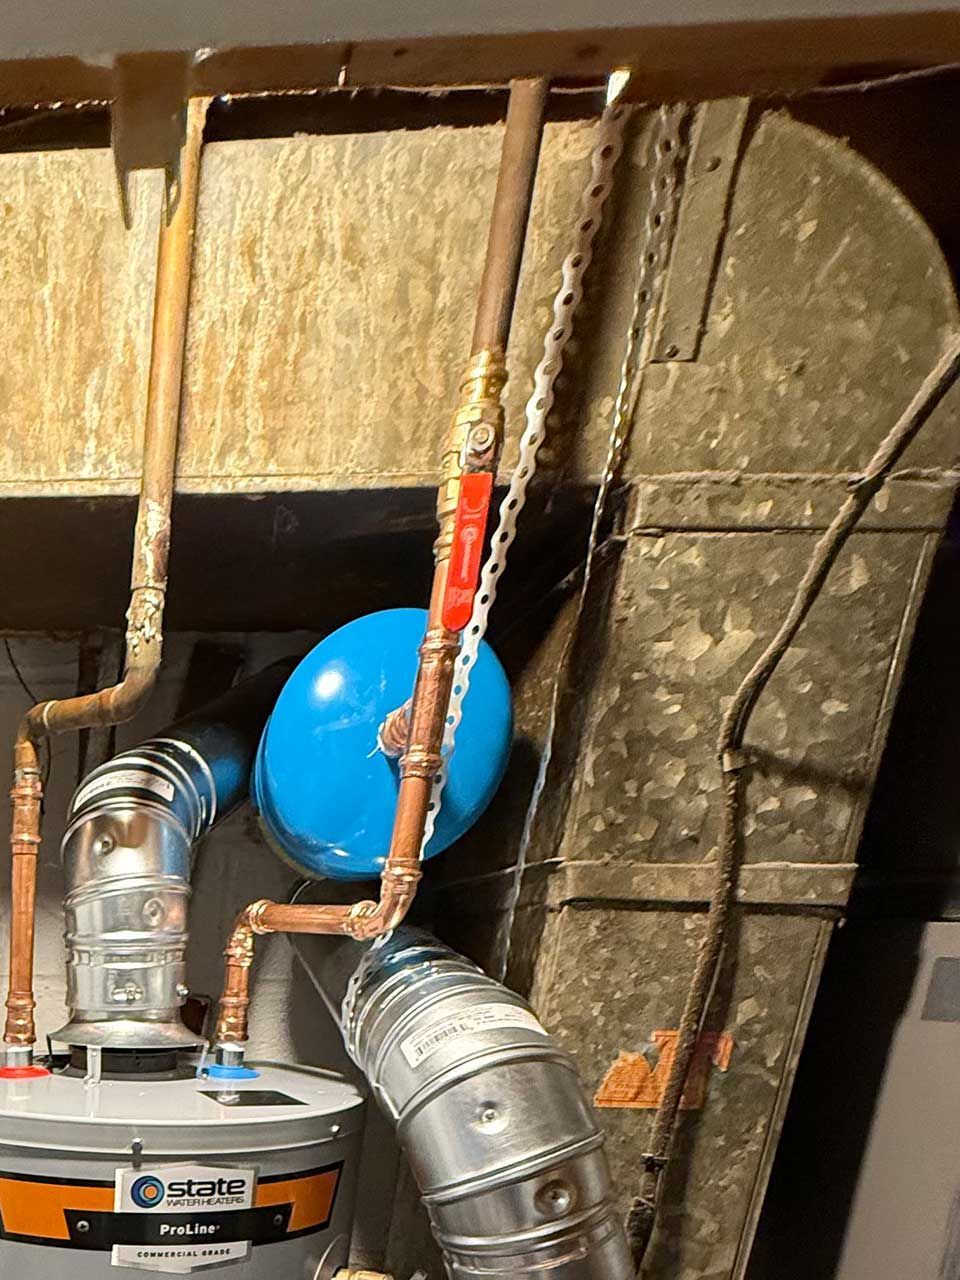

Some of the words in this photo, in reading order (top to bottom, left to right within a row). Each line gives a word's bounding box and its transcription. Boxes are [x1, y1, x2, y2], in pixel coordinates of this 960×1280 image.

[166, 1178, 246, 1198] state
[166, 1198, 201, 1207] WATER
[202, 1196, 244, 1206] HEATERS
